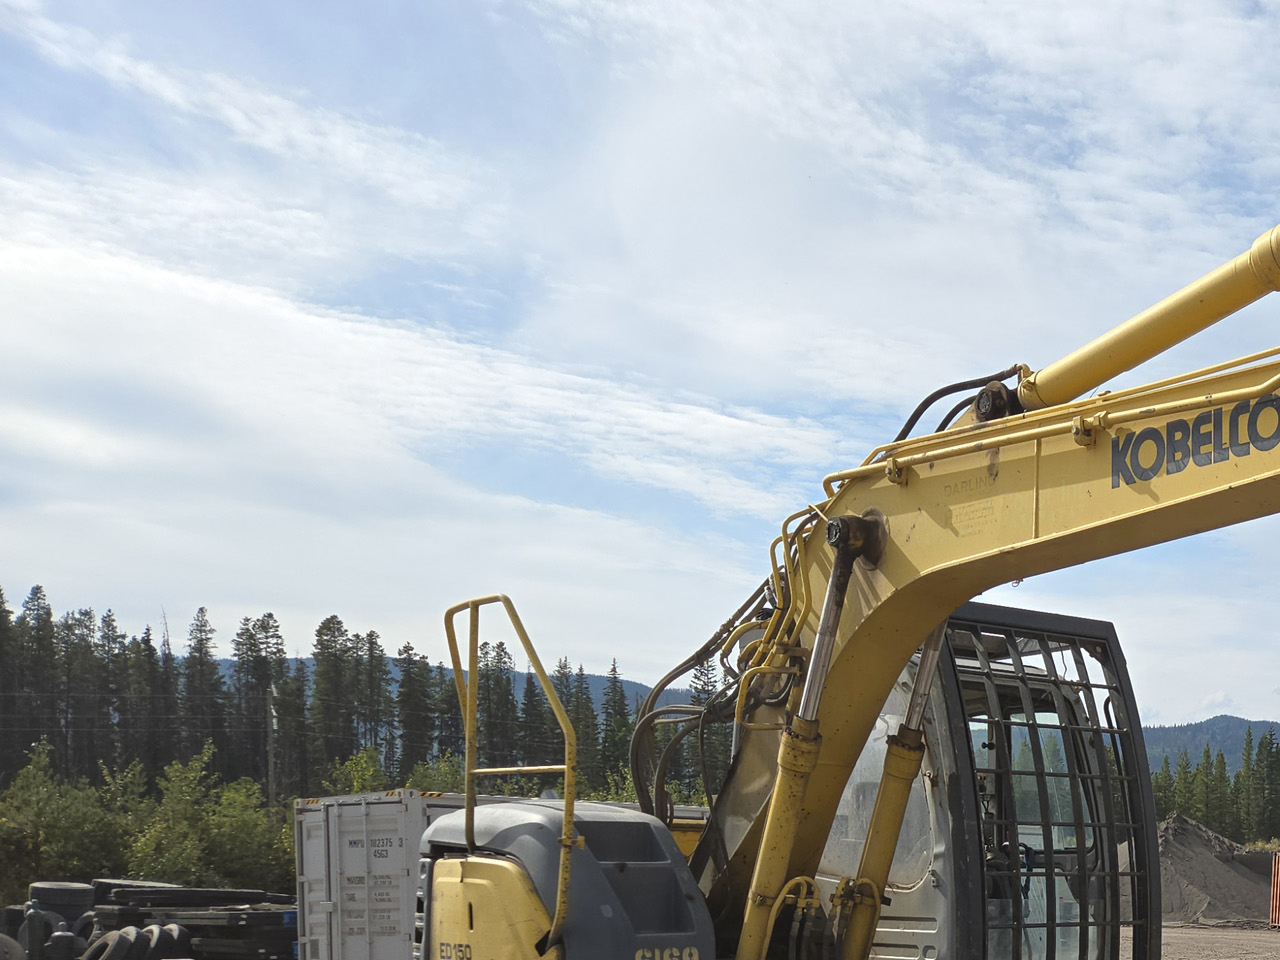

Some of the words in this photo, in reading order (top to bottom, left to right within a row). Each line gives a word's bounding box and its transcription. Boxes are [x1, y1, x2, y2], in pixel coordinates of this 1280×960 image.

[370, 837, 393, 848] 102375
[398, 837, 404, 848] 3
[439, 942, 472, 960] ED150
